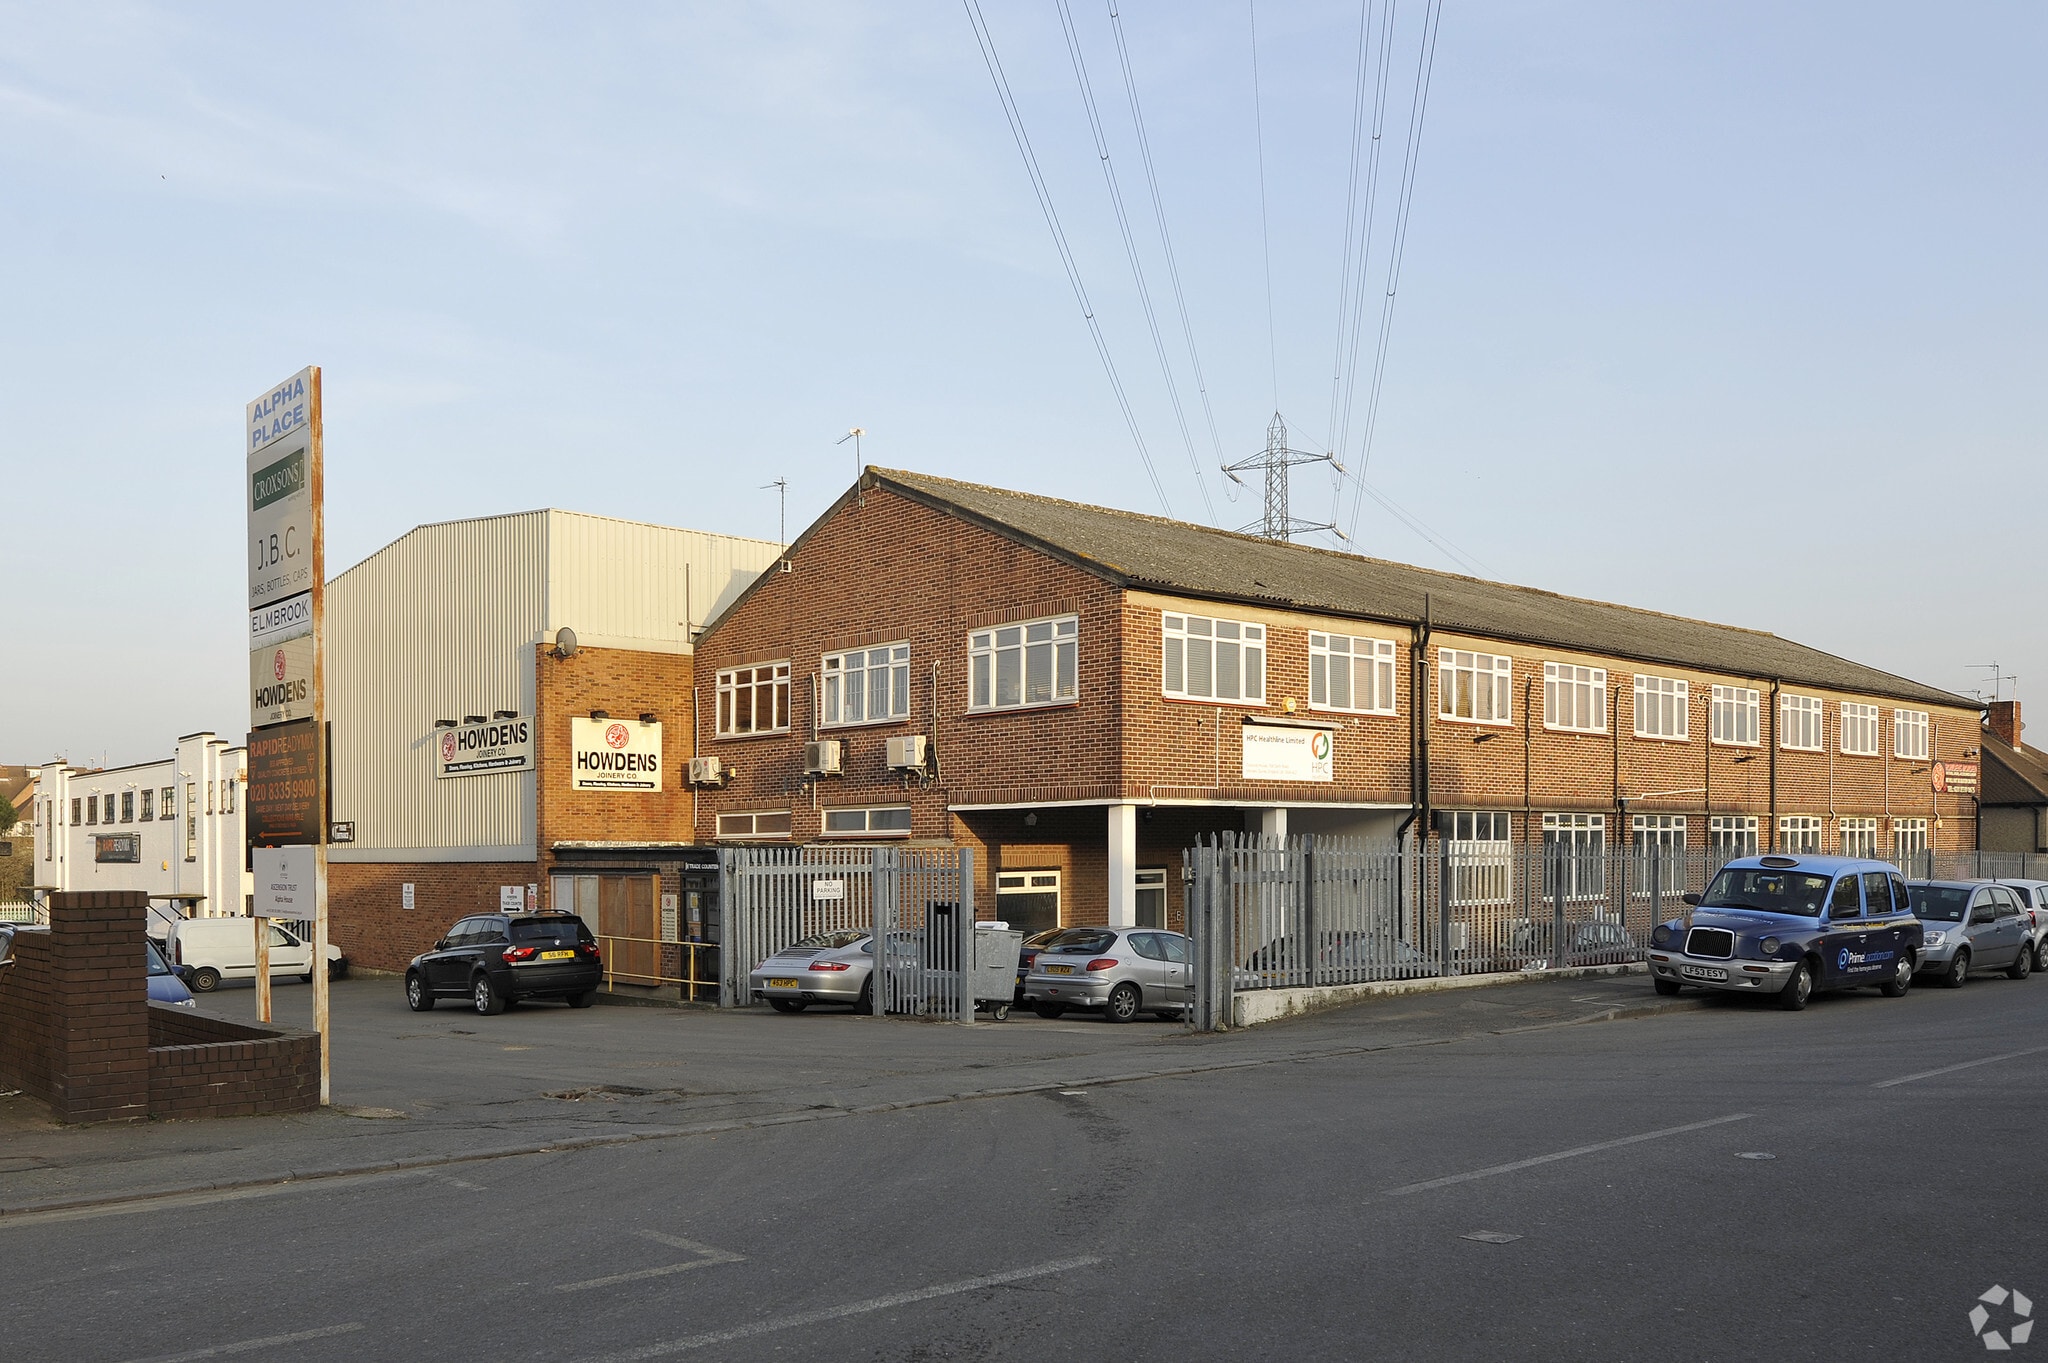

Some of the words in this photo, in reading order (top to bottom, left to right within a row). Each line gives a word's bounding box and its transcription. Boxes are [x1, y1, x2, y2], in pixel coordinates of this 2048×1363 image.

[253, 378, 304, 423] ALPHA
[253, 403, 303, 448] PLACE
[255, 463, 298, 501] CROXSONS
[258, 526, 300, 570] J.B.C.
[293, 567, 308, 582] CAPS
[252, 600, 308, 632] ELMBROOK
[256, 679, 306, 709] HOWDENS
[250, 732, 315, 757] RAPIDREADYMIX
[458, 722, 527, 750] HOWDENS
[1259, 736, 1284, 744] Healthline
[1286, 737, 1305, 745] Limited
[476, 749, 496, 758] JOINERY
[577, 751, 657, 772] HOWDENS
[1312, 762, 1328, 774] HPC
[250, 783, 266, 801] 020
[269, 781, 291, 800] 8335
[292, 779, 315, 798] 9900
[1684, 967, 1705, 976] LF53
[1707, 969, 1724, 978] ESY
